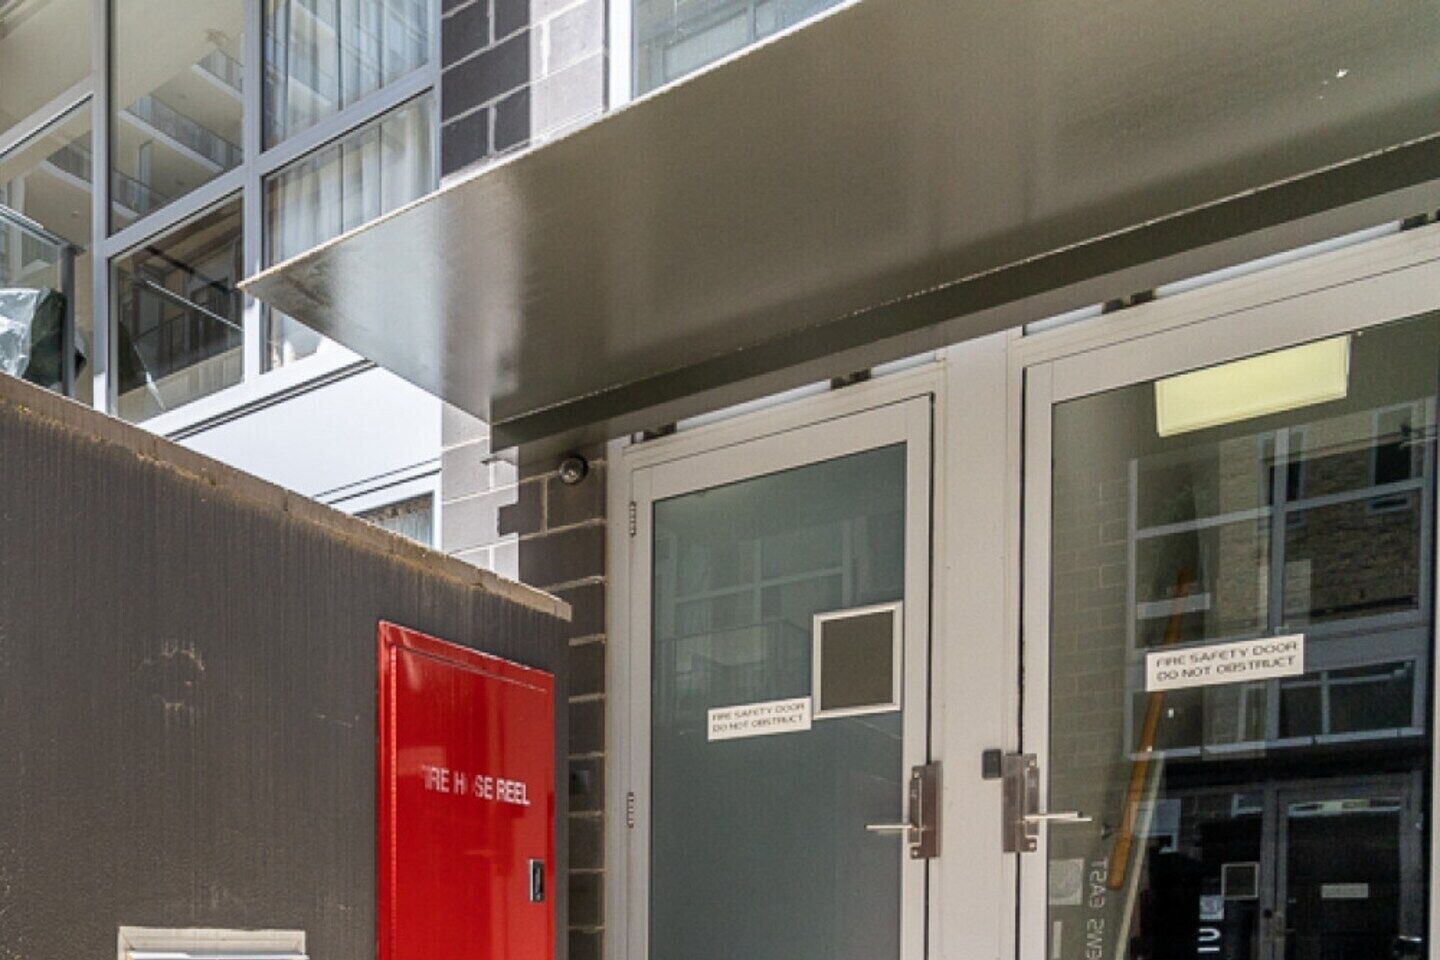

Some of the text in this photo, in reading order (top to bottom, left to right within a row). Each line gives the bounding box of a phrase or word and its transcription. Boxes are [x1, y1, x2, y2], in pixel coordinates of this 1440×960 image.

[1155, 641, 1296, 668] FIRE SAFETY DOOR
[1156, 656, 1295, 682] DO NOT OBSTRUCT
[454, 771, 493, 799] HSE
[496, 778, 530, 805] REEL
